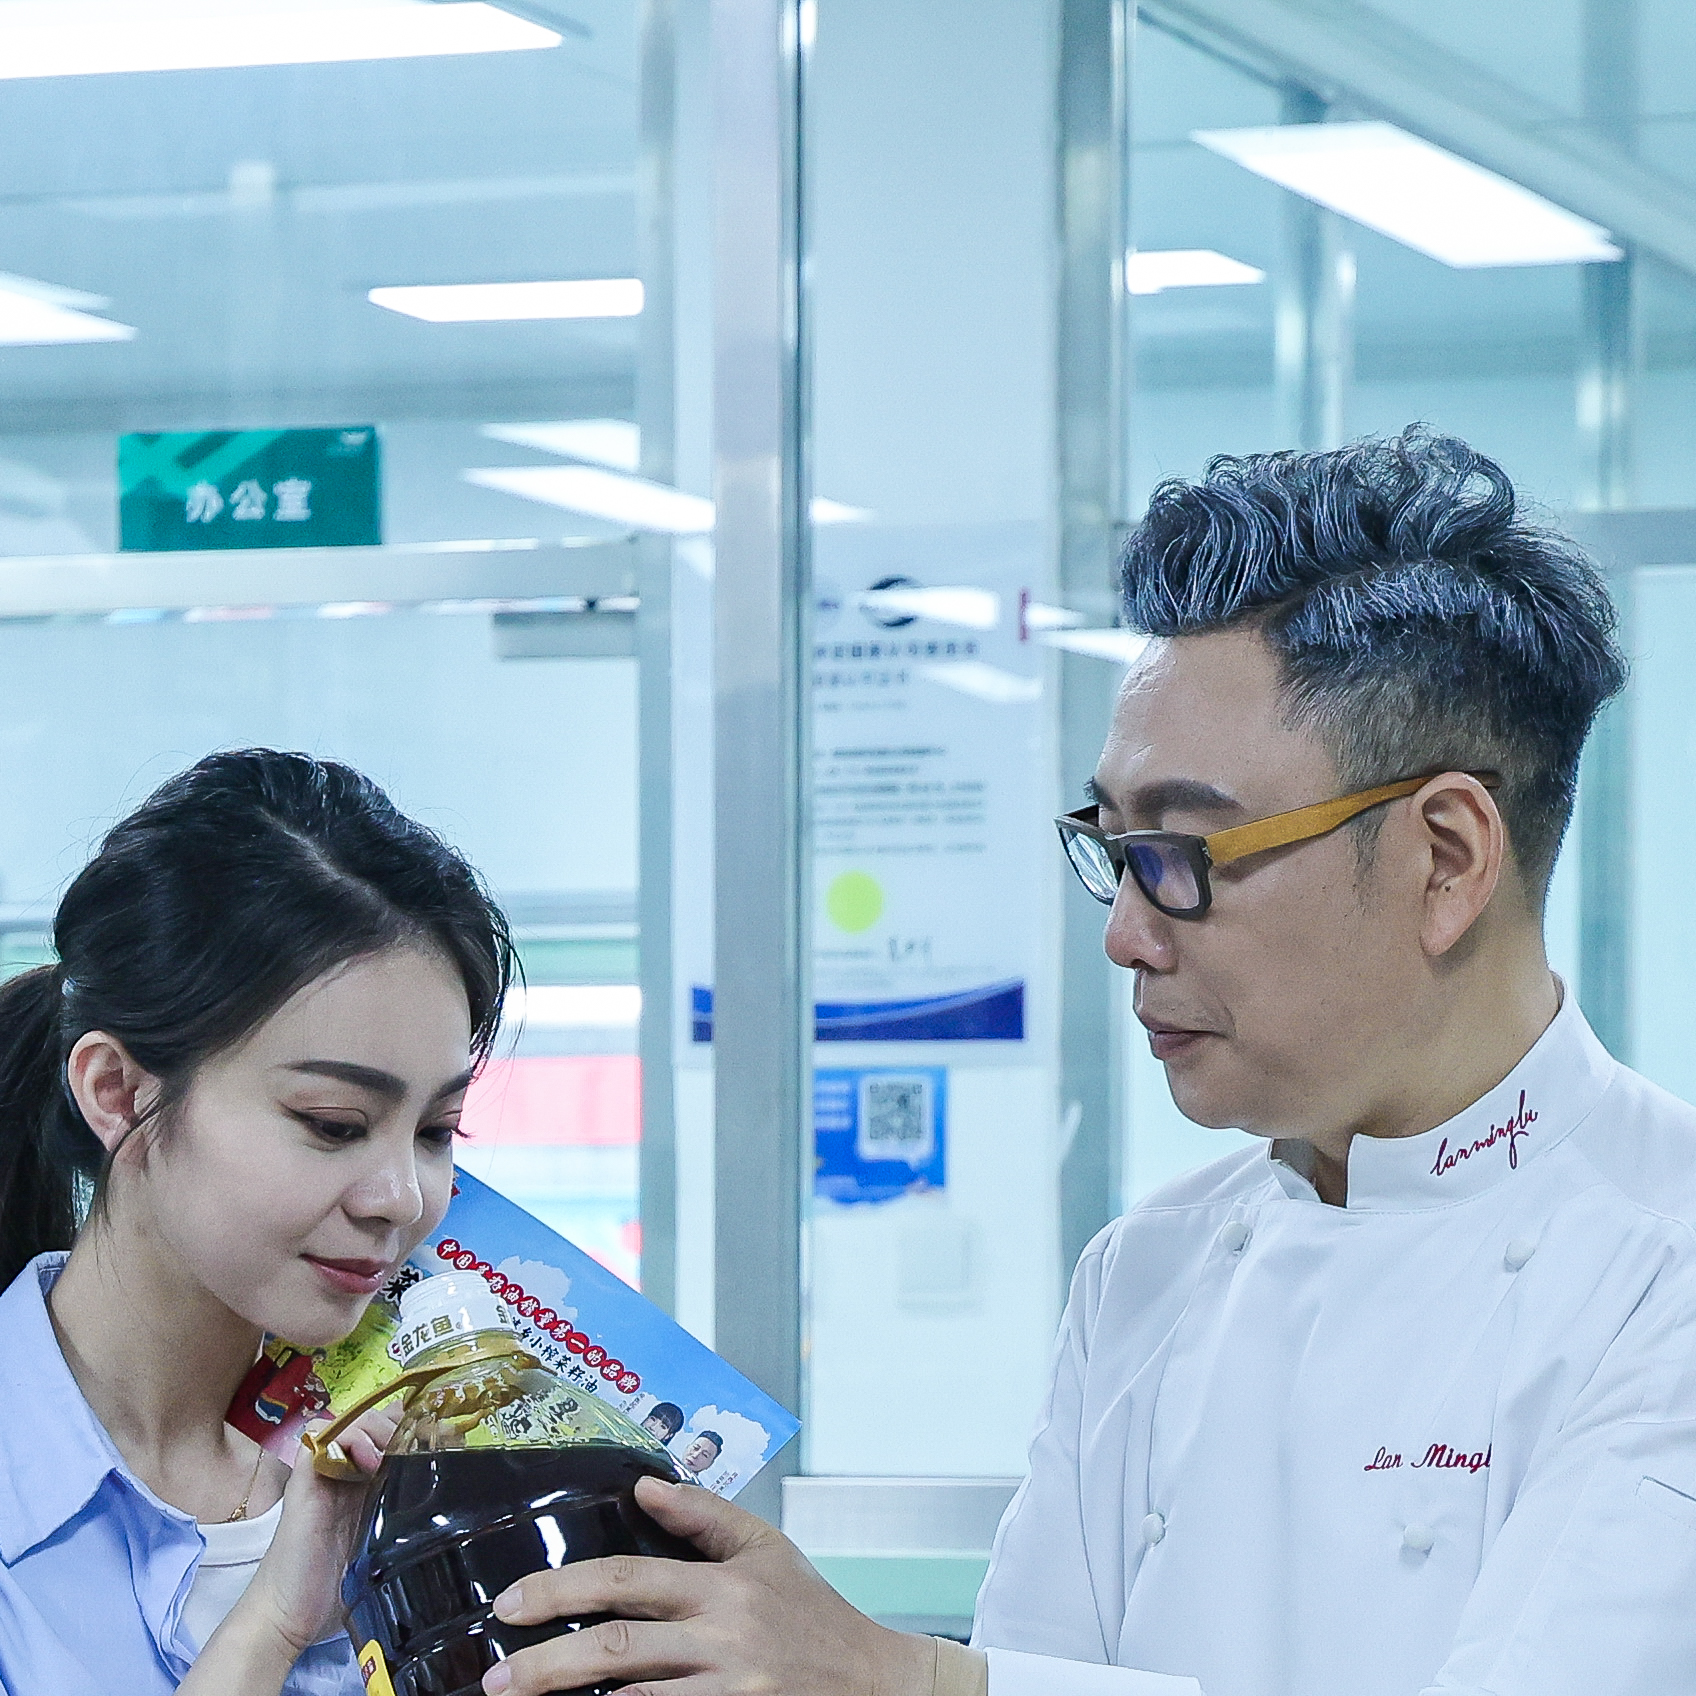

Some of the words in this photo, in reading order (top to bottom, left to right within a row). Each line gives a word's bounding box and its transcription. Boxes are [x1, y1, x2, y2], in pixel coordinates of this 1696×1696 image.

[184, 477, 313, 523] 办公室
[400, 1314, 454, 1357] 金龙鱼
[1364, 1446, 1403, 1471] Lan
